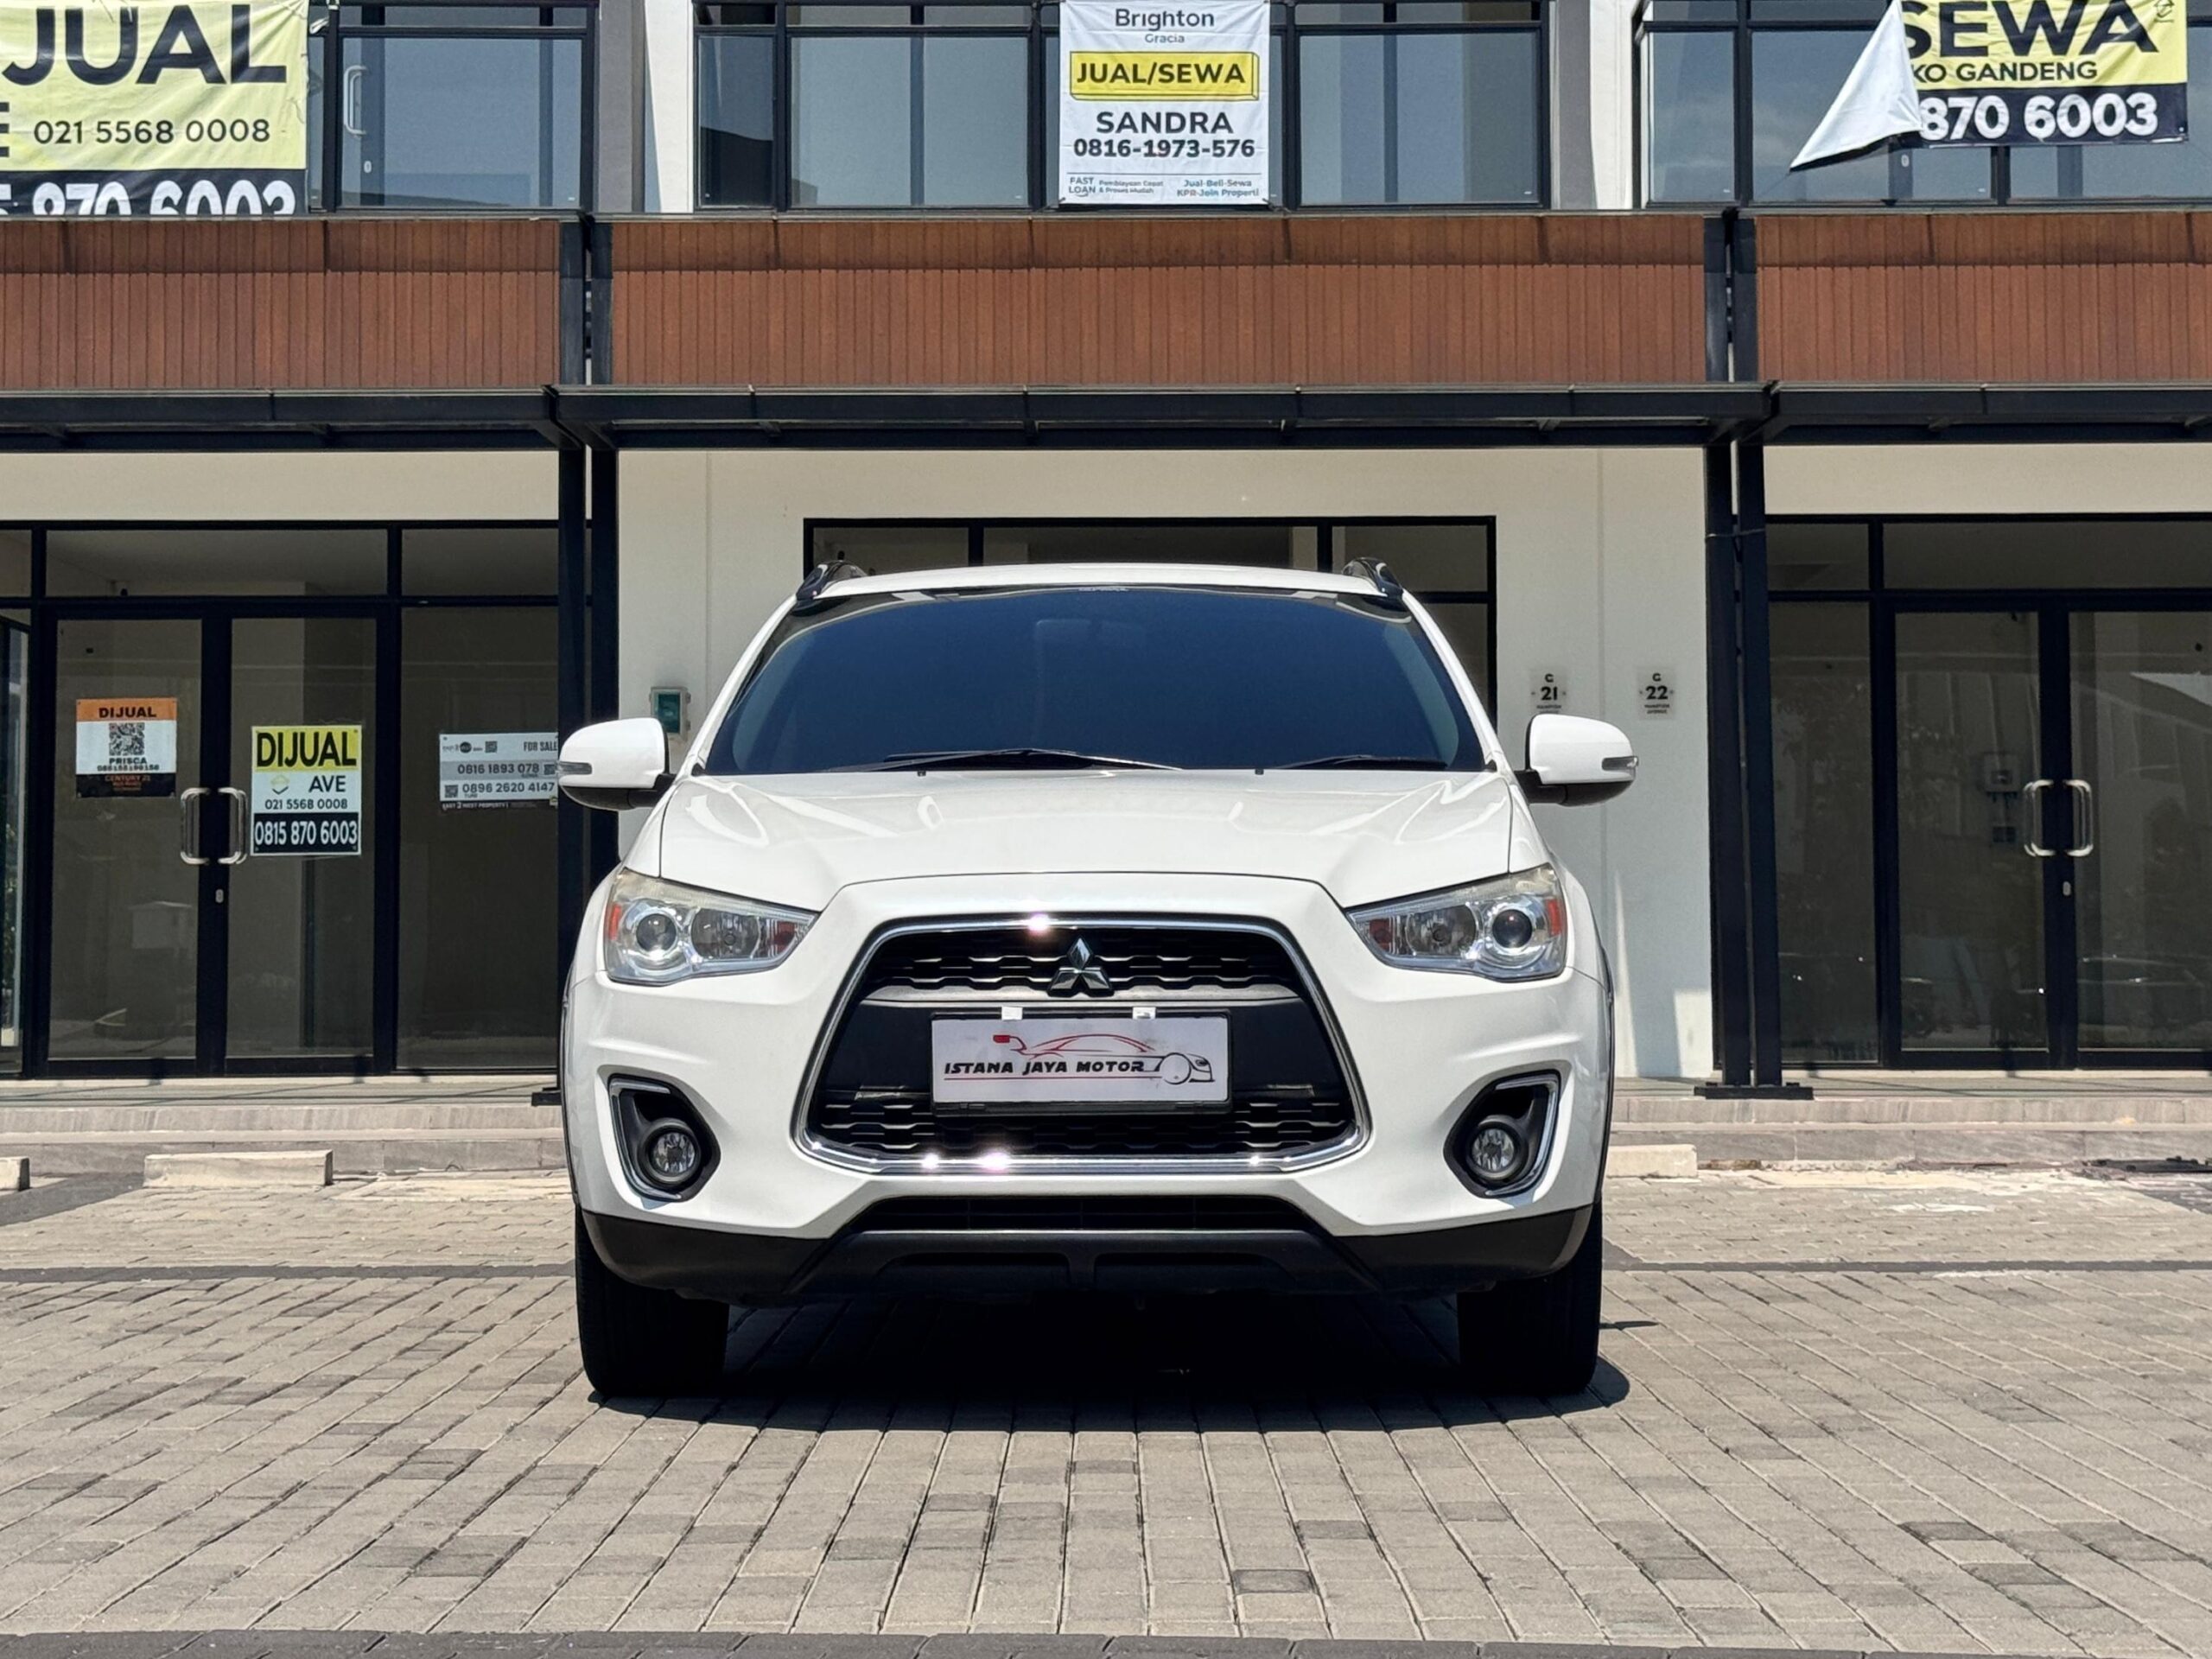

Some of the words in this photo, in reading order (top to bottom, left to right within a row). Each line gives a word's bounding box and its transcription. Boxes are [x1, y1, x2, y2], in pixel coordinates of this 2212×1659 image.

[1116, 9, 1214, 31] Brighton
[1145, 34, 1185, 43] Gracia
[1902, 0, 2159, 60] SEWA
[2, 4, 287, 86] JUAL
[1077, 62, 1245, 85] JUAL/SEWA
[1956, 60, 2098, 82] GANDENG
[1096, 111, 1234, 133] SANDRA
[1918, 94, 2010, 141] 870
[2024, 92, 2158, 139] 6003
[34, 121, 83, 144] 021
[96, 120, 174, 143] 5568
[186, 118, 270, 143] 0008
[1074, 139, 1255, 157] 0816-1973-576
[1070, 176, 1094, 185] FAST
[1541, 686, 1558, 701] 21
[1645, 686, 1669, 700] 22
[99, 707, 156, 718] DIJUAL
[257, 732, 357, 767] DIJUAL
[524, 741, 537, 751] FOR
[540, 741, 557, 751] SALE
[457, 764, 485, 774] 0816
[488, 763, 515, 774] 1893
[518, 763, 540, 773] 078
[308, 775, 346, 792] AVE
[462, 783, 493, 793] 0896
[496, 782, 524, 792] 2620
[528, 782, 555, 792] 4147
[265, 799, 283, 810] 021
[287, 799, 314, 810] 5568
[317, 798, 348, 810] 0008
[254, 821, 287, 845] 0815
[290, 820, 316, 845] 870
[320, 820, 358, 845] 6003
[944, 1062, 1014, 1074] ISTANA
[1022, 1061, 1067, 1075] JAYA
[1077, 1061, 1145, 1072] MOTOR
